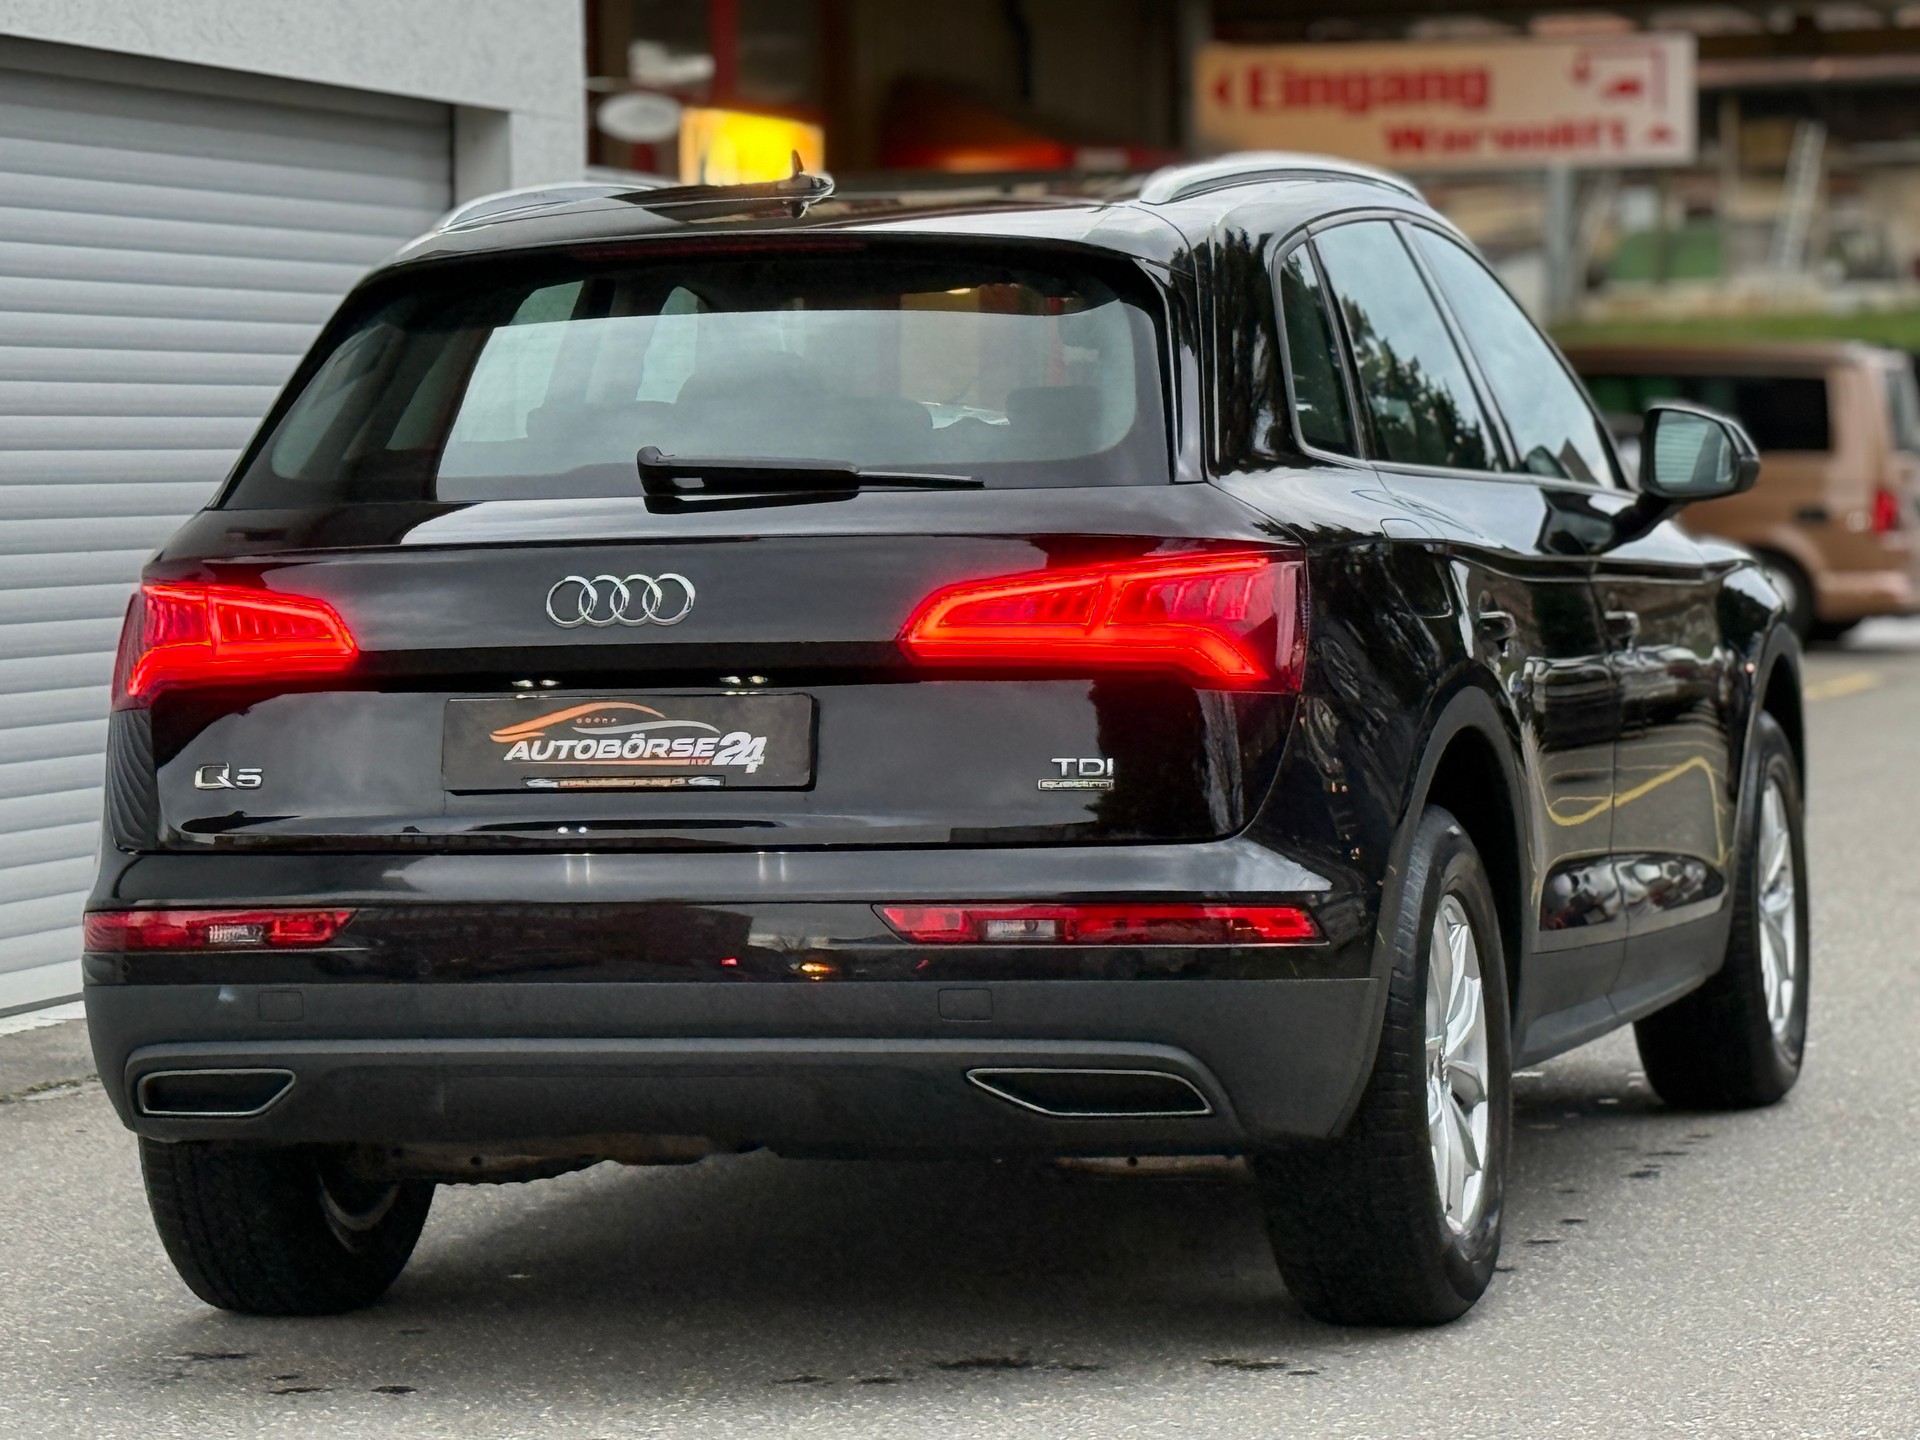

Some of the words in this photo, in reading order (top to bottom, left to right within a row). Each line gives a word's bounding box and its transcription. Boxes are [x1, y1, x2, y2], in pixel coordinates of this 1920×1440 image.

[1248, 64, 1491, 110] Eingang
[194, 762, 263, 790] Q5
[1050, 757, 1114, 777] TDI
